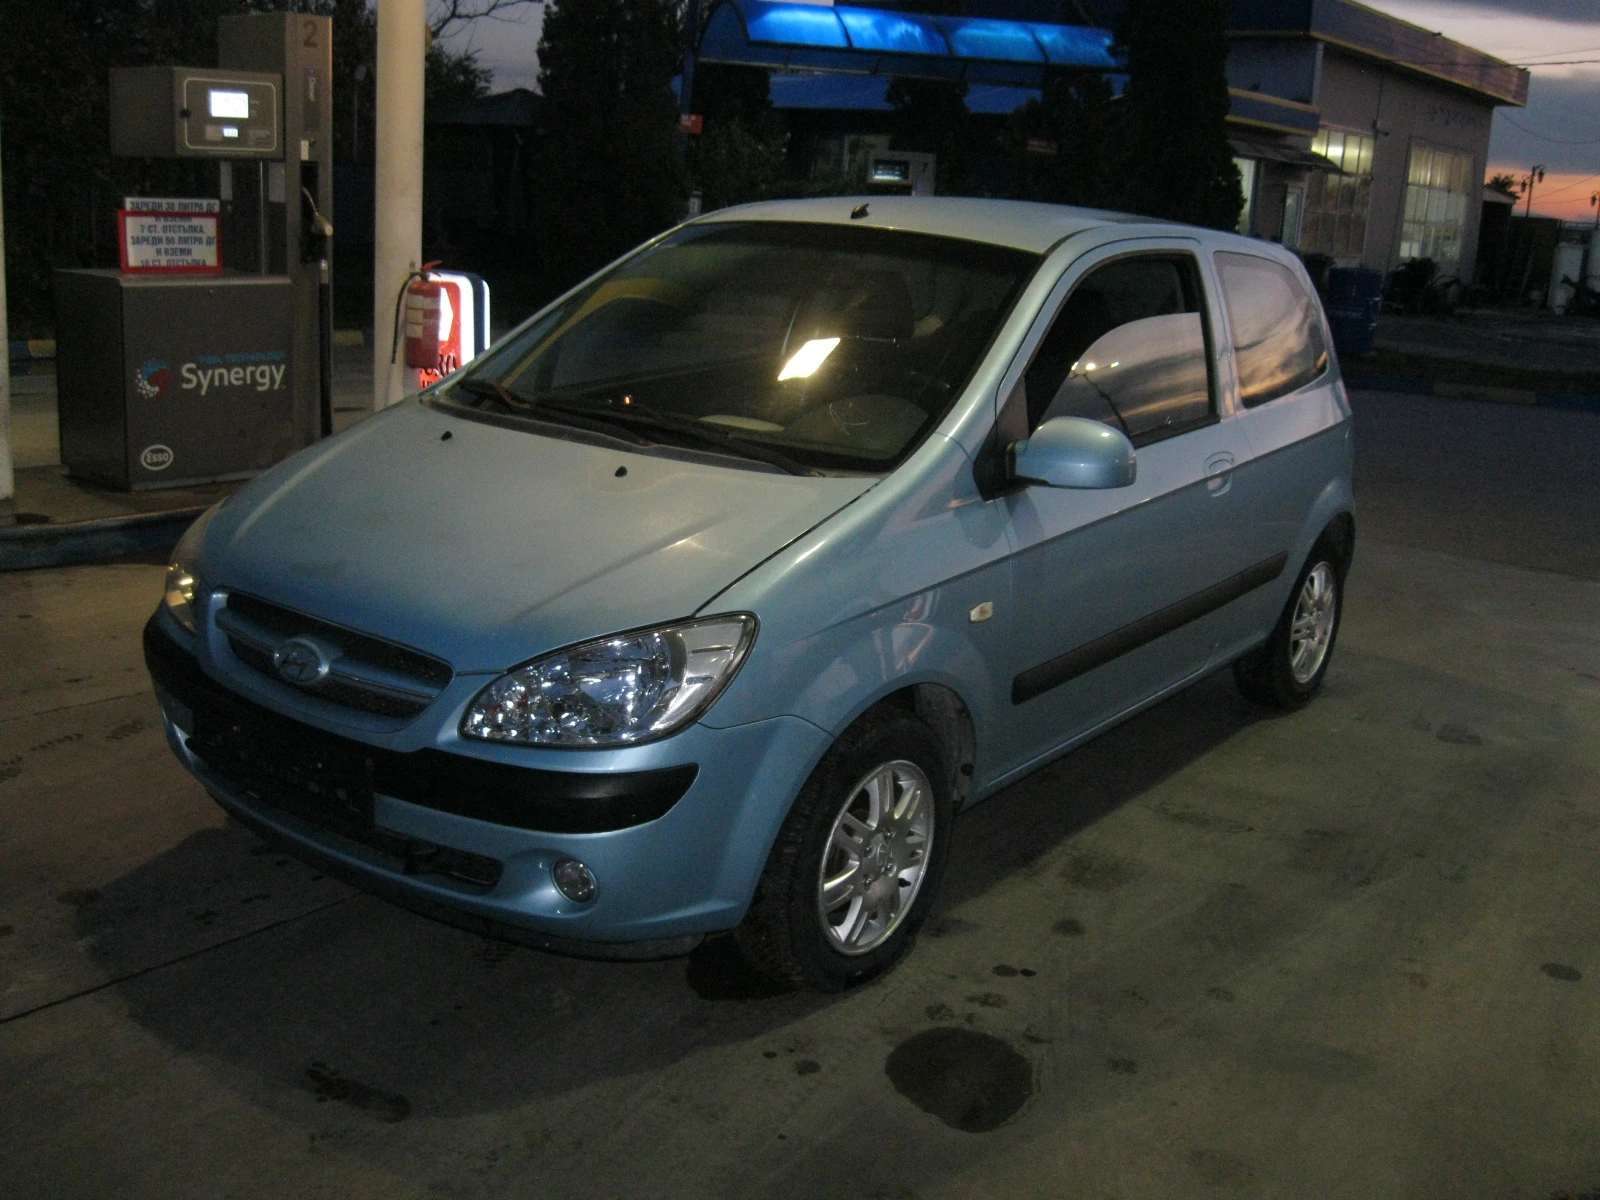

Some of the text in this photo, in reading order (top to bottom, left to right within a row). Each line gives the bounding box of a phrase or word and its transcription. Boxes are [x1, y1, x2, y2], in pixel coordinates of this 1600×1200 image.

[303, 20, 318, 47] 2
[140, 225, 145, 234] 7
[130, 236, 163, 246] ЗАРЕДИ
[155, 248, 192, 257] И ВЗЕМИ
[181, 362, 286, 396] Synergy
[146, 452, 168, 464] Esso
